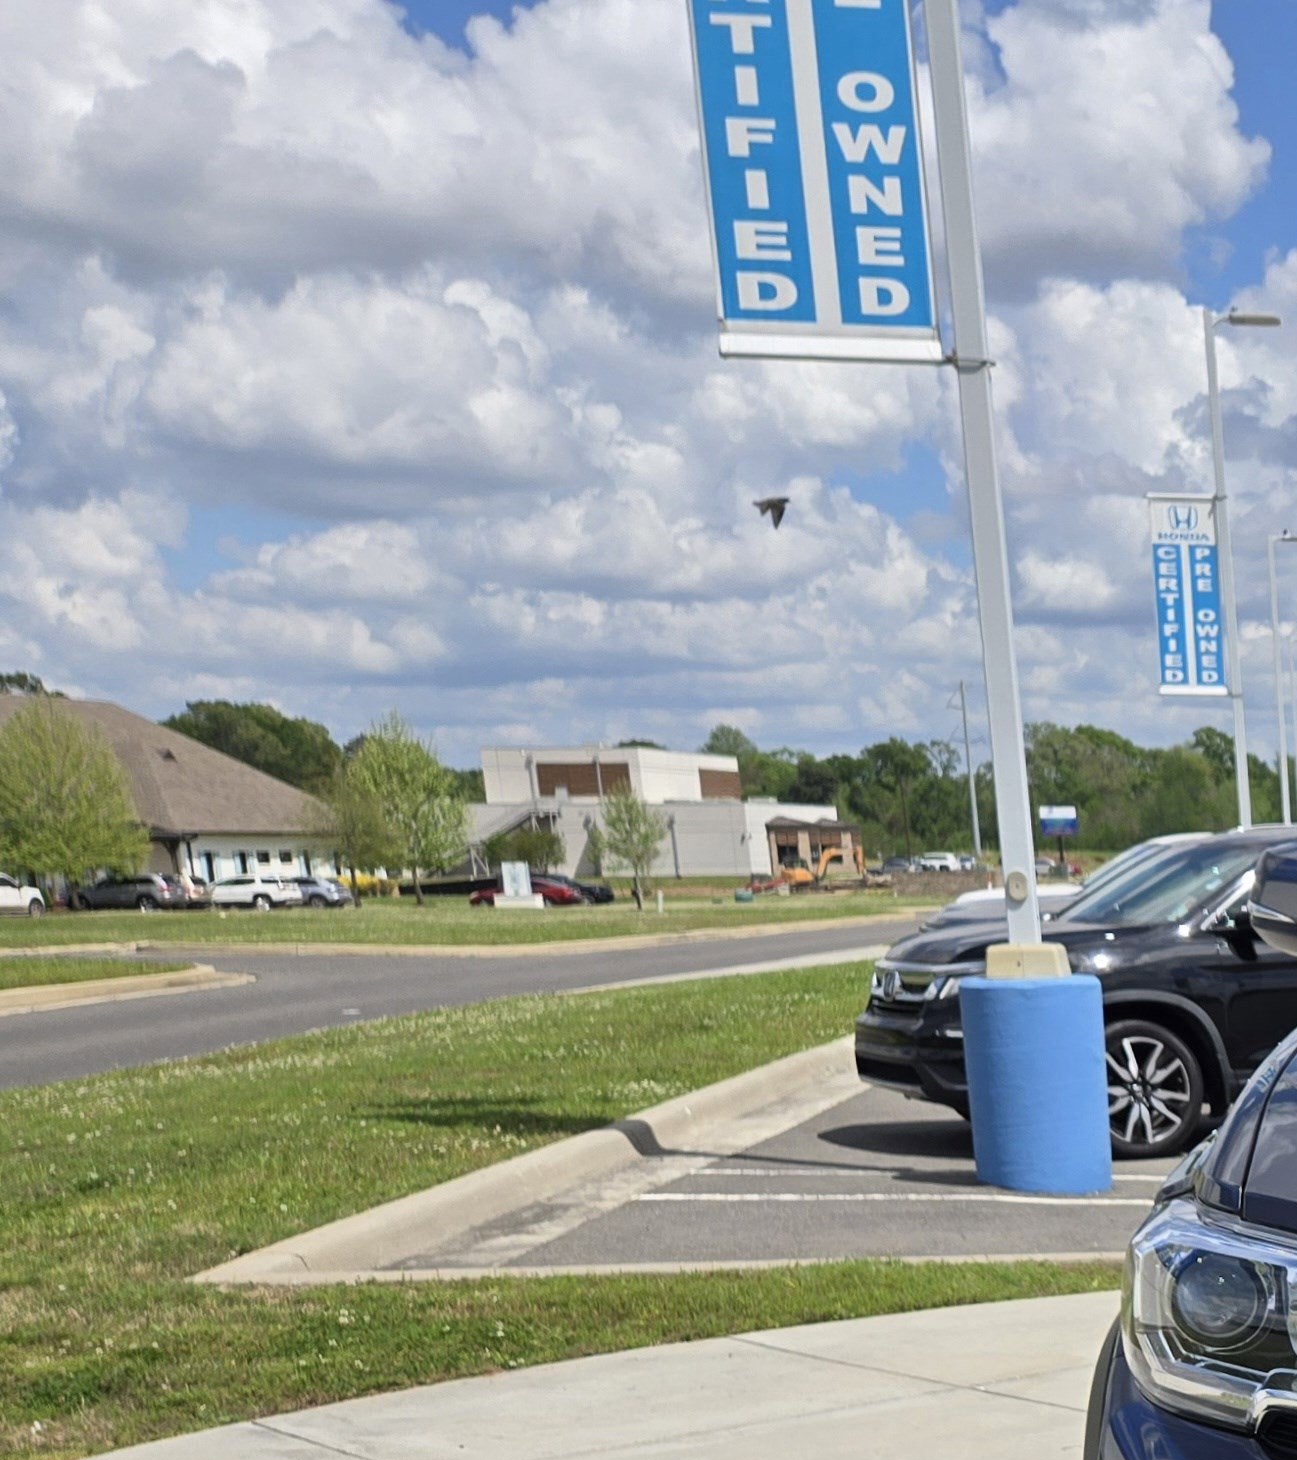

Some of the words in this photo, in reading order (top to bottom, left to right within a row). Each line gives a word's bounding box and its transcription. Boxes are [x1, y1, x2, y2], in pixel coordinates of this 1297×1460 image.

[709, 0, 798, 312] TIFIED
[831, 71, 908, 316] OWNED
[1157, 532, 1210, 542] HONDA
[1195, 547, 1213, 592] PRE
[1156, 546, 1185, 683] CERTIFIED
[1196, 608, 1219, 683] OWNED
